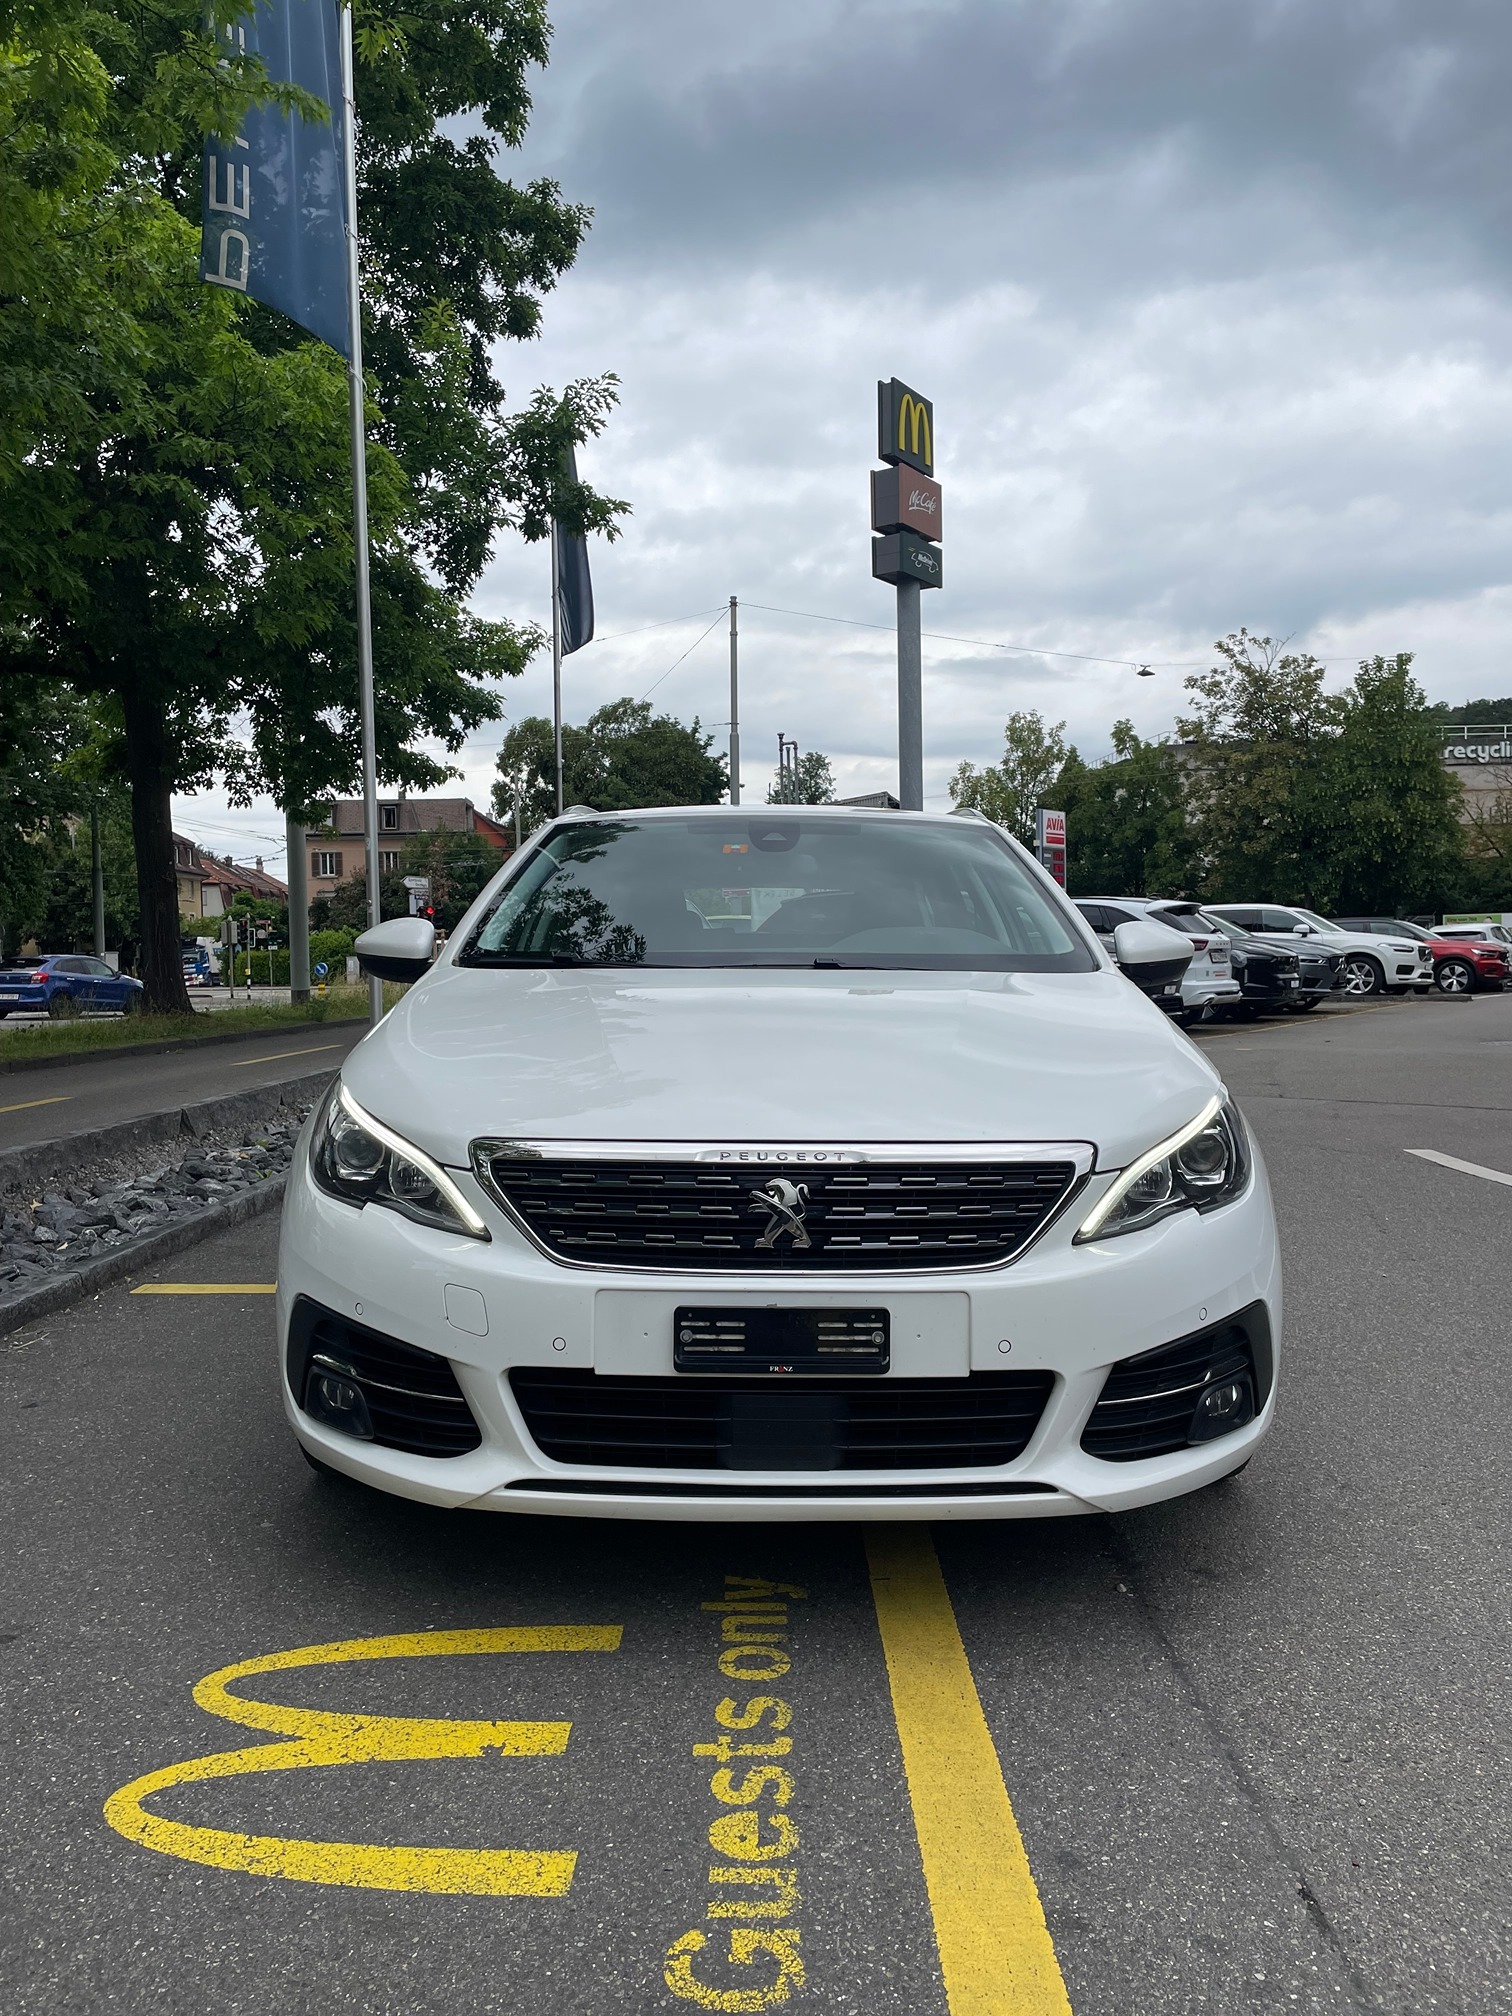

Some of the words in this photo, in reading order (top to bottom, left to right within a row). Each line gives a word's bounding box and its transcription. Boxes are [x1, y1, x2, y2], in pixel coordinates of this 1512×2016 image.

[1443, 740, 1511, 764] recycli
[719, 1151, 846, 1162] PEUGEOT
[700, 1575, 807, 1681] only
[663, 1696, 805, 2012] Guests
